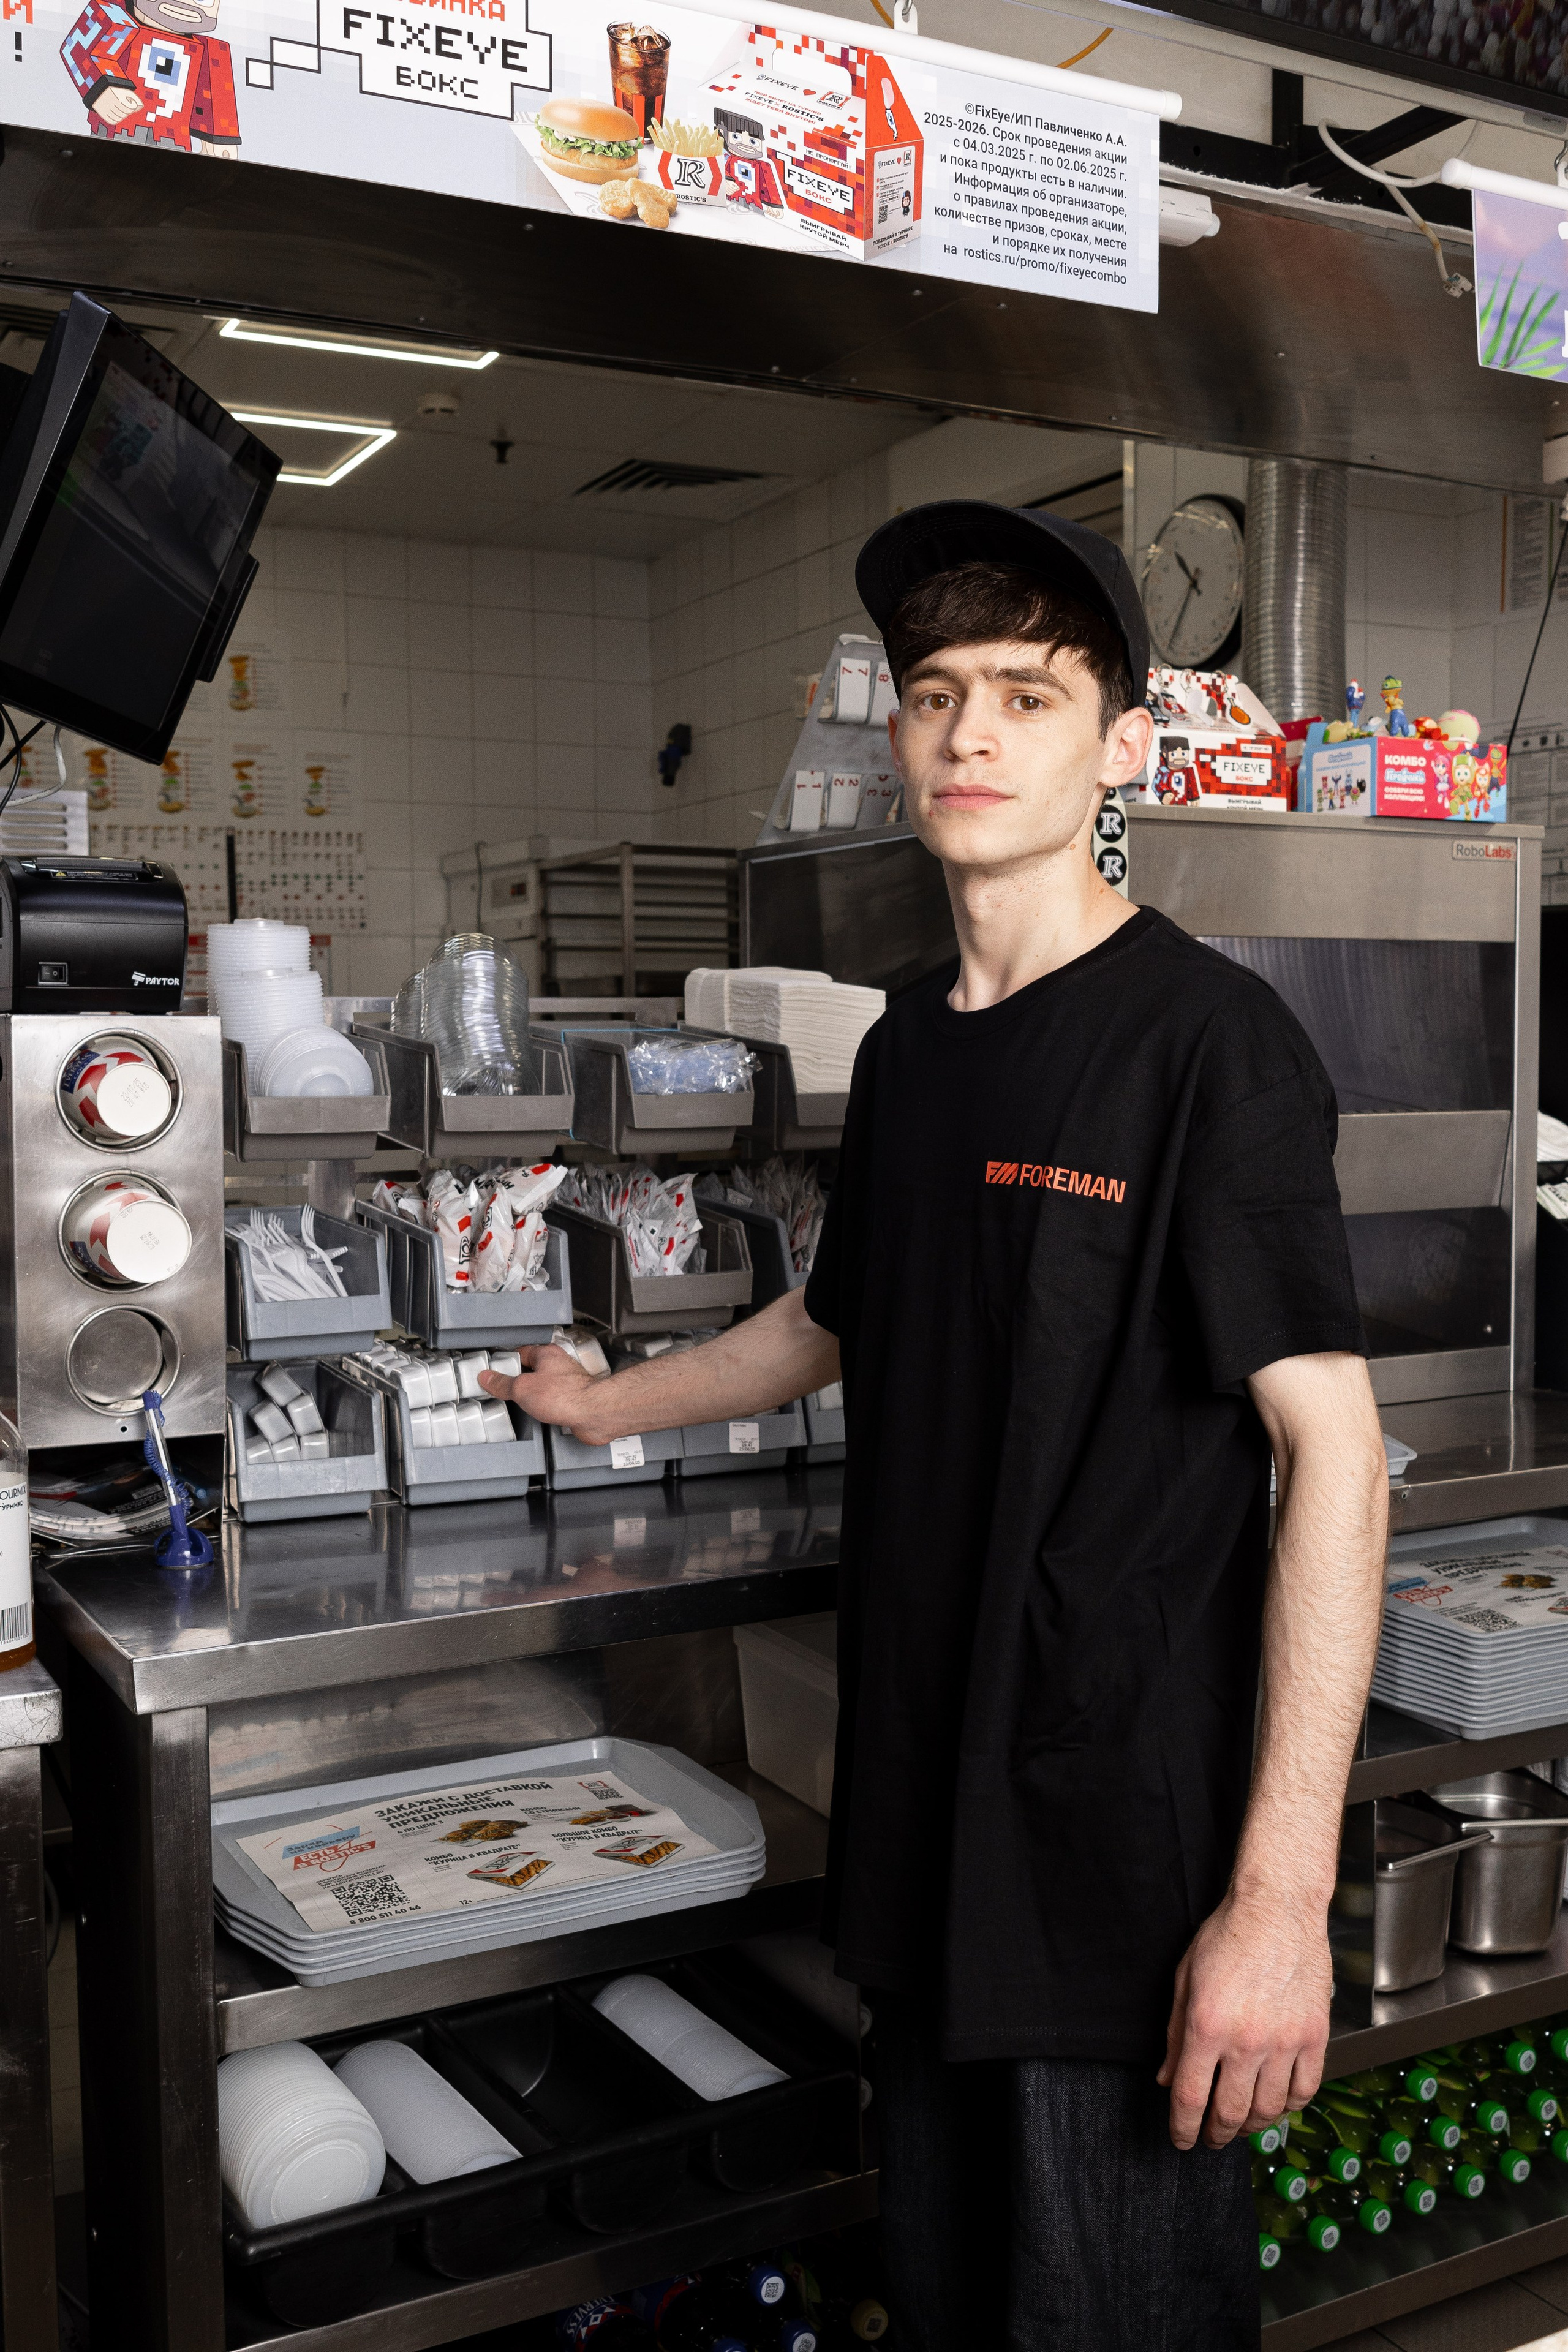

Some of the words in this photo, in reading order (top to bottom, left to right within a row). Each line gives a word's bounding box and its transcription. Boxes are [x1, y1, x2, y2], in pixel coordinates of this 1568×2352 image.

[344, 7, 527, 73] FIXEYE
[396, 66, 478, 99] БОКС
[766, 77, 799, 91] FIXEYE
[744, 92, 776, 105] FIXEYE
[781, 104, 824, 122] ROSTIC'S
[745, 98, 766, 107] ЖДЕТ
[766, 104, 785, 113] ТЕБЯ
[785, 111, 816, 124] ВНУТРИ!
[797, 104, 821, 115] ТУРНИР
[818, 100, 841, 109] ROSTIC'S
[924, 112, 989, 135] 2025-2026.
[993, 126, 1021, 142] Срок
[1025, 135, 1091, 157] проведения
[1095, 149, 1128, 164] акции
[1036, 117, 1102, 141] Павличенко
[1106, 133, 1127, 146] А.А.
[816, 153, 851, 170] ПРОМОРГАЙ!
[963, 138, 1025, 160] 04.03.2025
[1029, 154, 1036, 163] г.
[1041, 156, 1054, 166] по
[1057, 157, 1117, 179] 02.06.2025
[1120, 172, 1127, 181] г.
[675, 158, 706, 189] R
[787, 168, 850, 202] FIXEYE
[940, 154, 946, 163] и
[951, 156, 978, 169] пока
[982, 162, 1036, 181] продукты
[1041, 174, 1065, 186] есть
[1069, 179, 1075, 188] в
[1079, 181, 1127, 198] наличии.
[676, 194, 706, 203] ROSTIC'S
[805, 189, 832, 204] БОКС
[954, 172, 1029, 197] Информация
[1033, 189, 1046, 200] об
[1049, 193, 1127, 217] организаторе,
[954, 192, 960, 201] о
[964, 194, 1018, 213] правилах
[1022, 205, 1088, 225] проведения
[1091, 218, 1127, 235] акции,
[799, 224, 827, 239] КРУТОЙ
[829, 236, 850, 249] МЕРЧ
[801, 218, 846, 241] ВЫИГРЫВАЙ
[872, 233, 894, 246] ПОБЕЖДАЙ
[897, 226, 913, 236] ТУРНИРЕ
[935, 206, 1001, 227] количестве
[1005, 220, 1047, 238] призов,
[1050, 228, 1091, 245] сроках,
[1095, 236, 1127, 250] месте
[878, 241, 890, 250] FIXEYE
[893, 233, 909, 244] ROSTIC'S
[993, 235, 999, 244] и
[1003, 237, 1050, 254] порядке
[1054, 246, 1066, 257] их
[1069, 249, 1126, 267] получения
[944, 244, 957, 255] на
[964, 247, 1126, 284] rostics.ru/promo/fixeyecombo
[1224, 762, 1265, 774] FIXEYE
[1384, 755, 1427, 767] КОМБО
[146, 977, 179, 986] PAYTOR
[1019, 1164, 1126, 1203] FOREMAN
[374, 1796, 445, 1817] ЗАКАЖИ
[461, 1781, 554, 1800] ДОСТАВКОЙ
[380, 1796, 495, 1822] УНИКАЛЬНЫЕ
[388, 1800, 516, 1829] ПРЕДЛОЖЕНИЯ
[417, 1822, 438, 1831] ЦЕНЕ
[287, 1840, 325, 1851] Заряд
[305, 1834, 356, 1851] карьеру
[601, 1829, 643, 1839] КВАДРАТЕ"
[299, 1847, 336, 1862] ЕСТЬ
[311, 1844, 372, 1865] ROSTIC'S
[424, 1853, 453, 1862] КОМБО
[428, 1856, 468, 1866] "КУРИЦА
[475, 1844, 521, 1857] КВАДРАТЕ"
